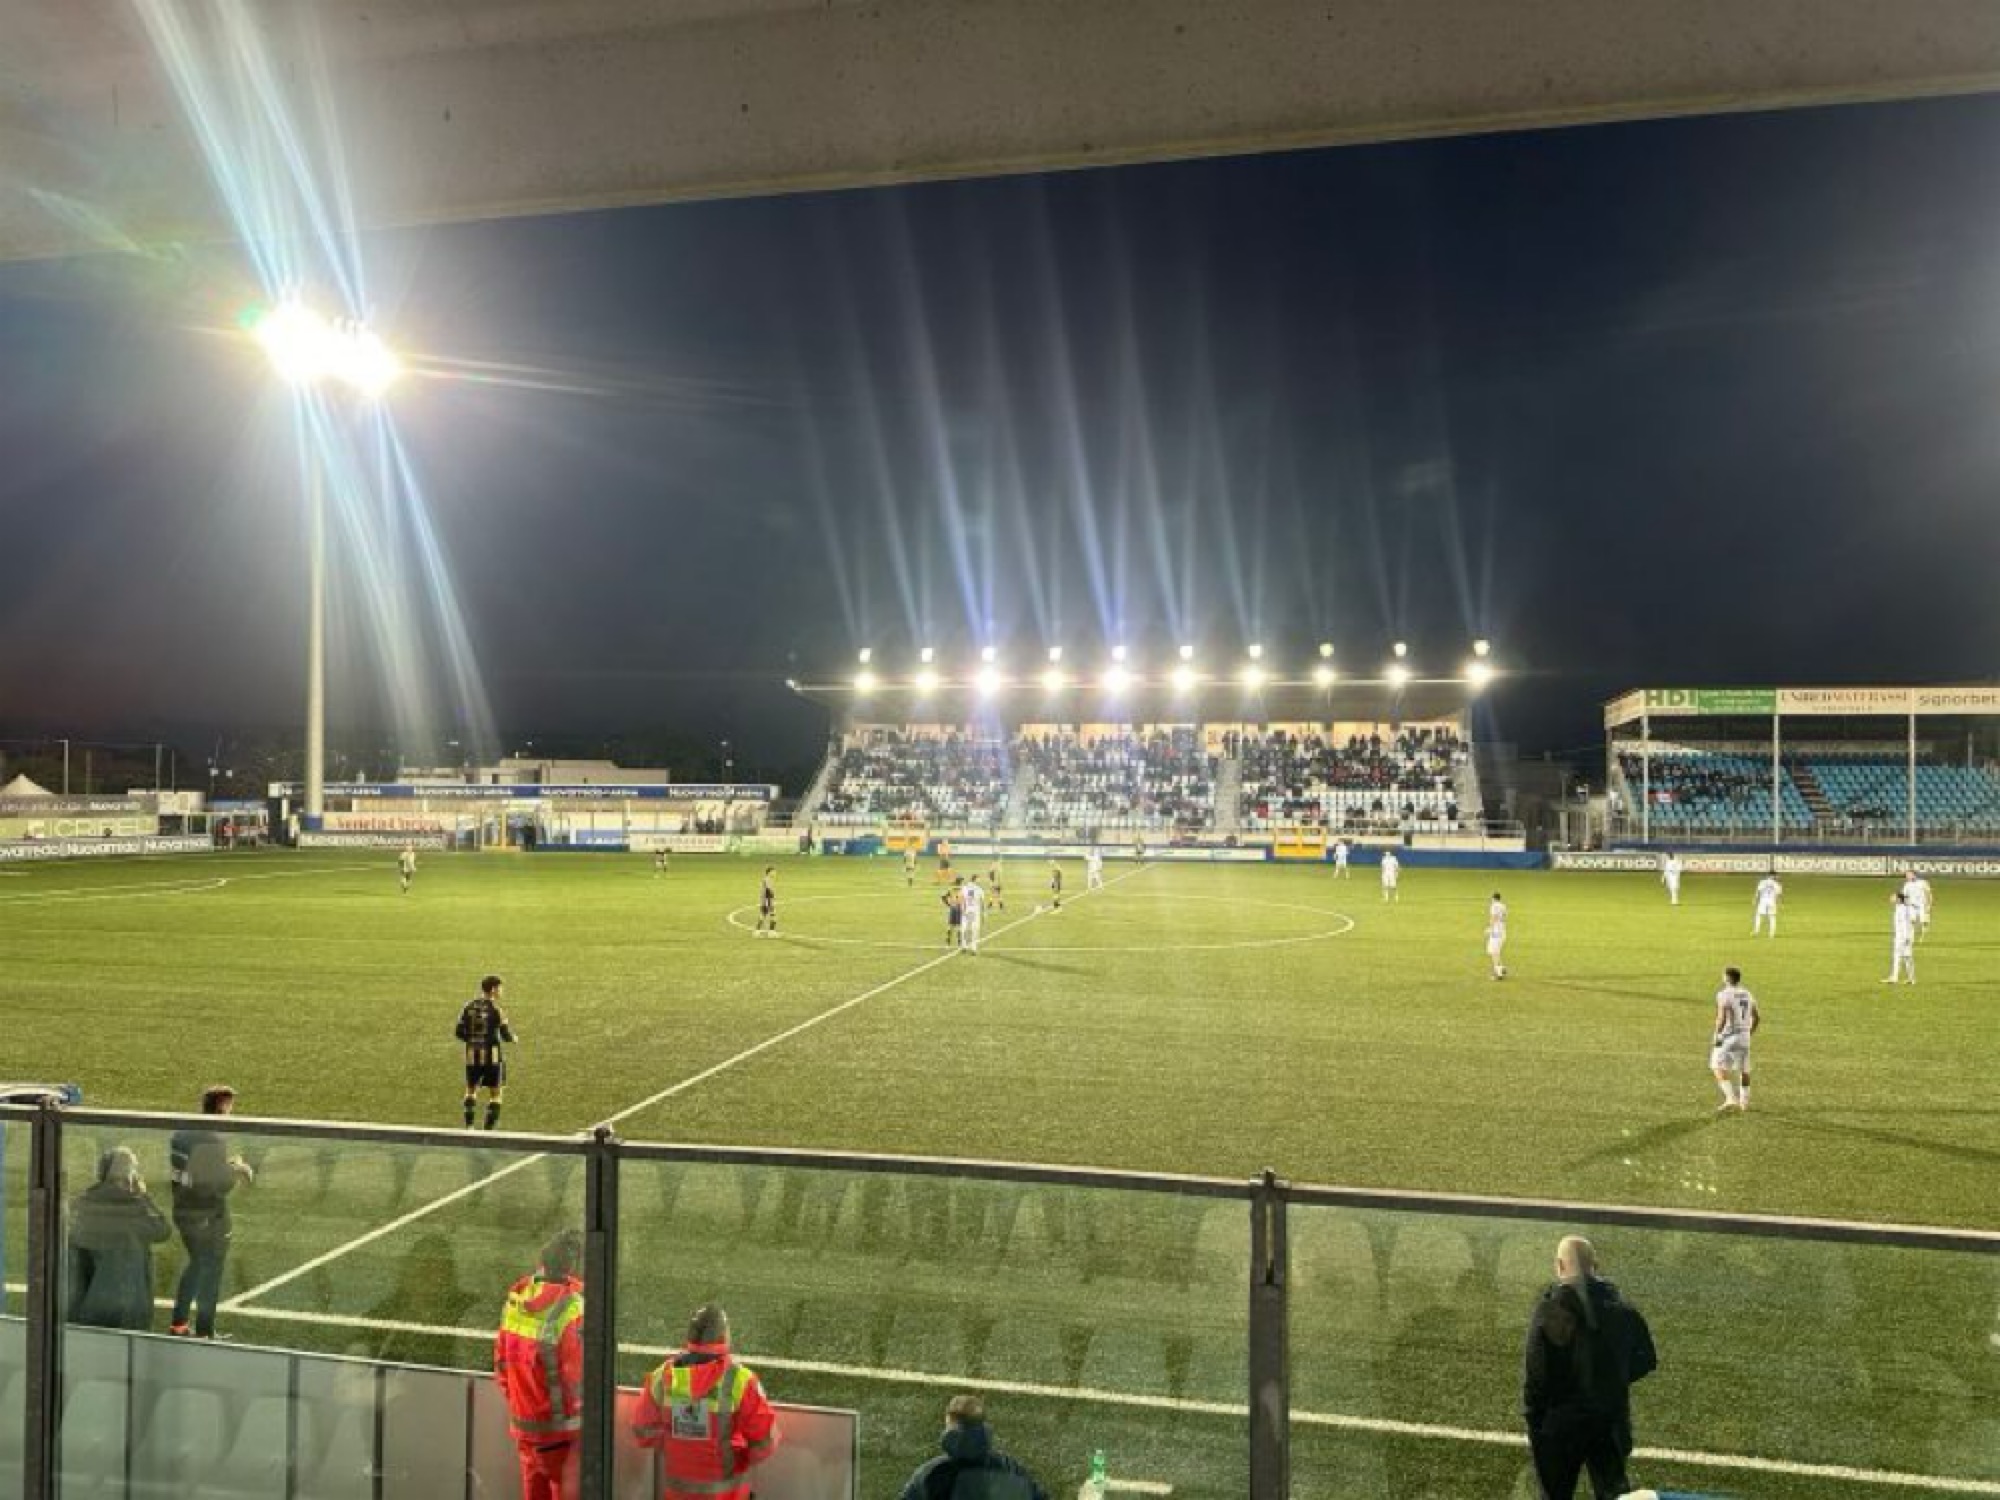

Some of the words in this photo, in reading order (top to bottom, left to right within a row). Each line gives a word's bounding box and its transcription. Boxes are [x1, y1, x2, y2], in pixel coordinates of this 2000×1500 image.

[1646, 690, 1698, 707] HDI
[1557, 855, 1657, 869] Nuovarredo
[1781, 856, 1881, 871] Nuovarredo
